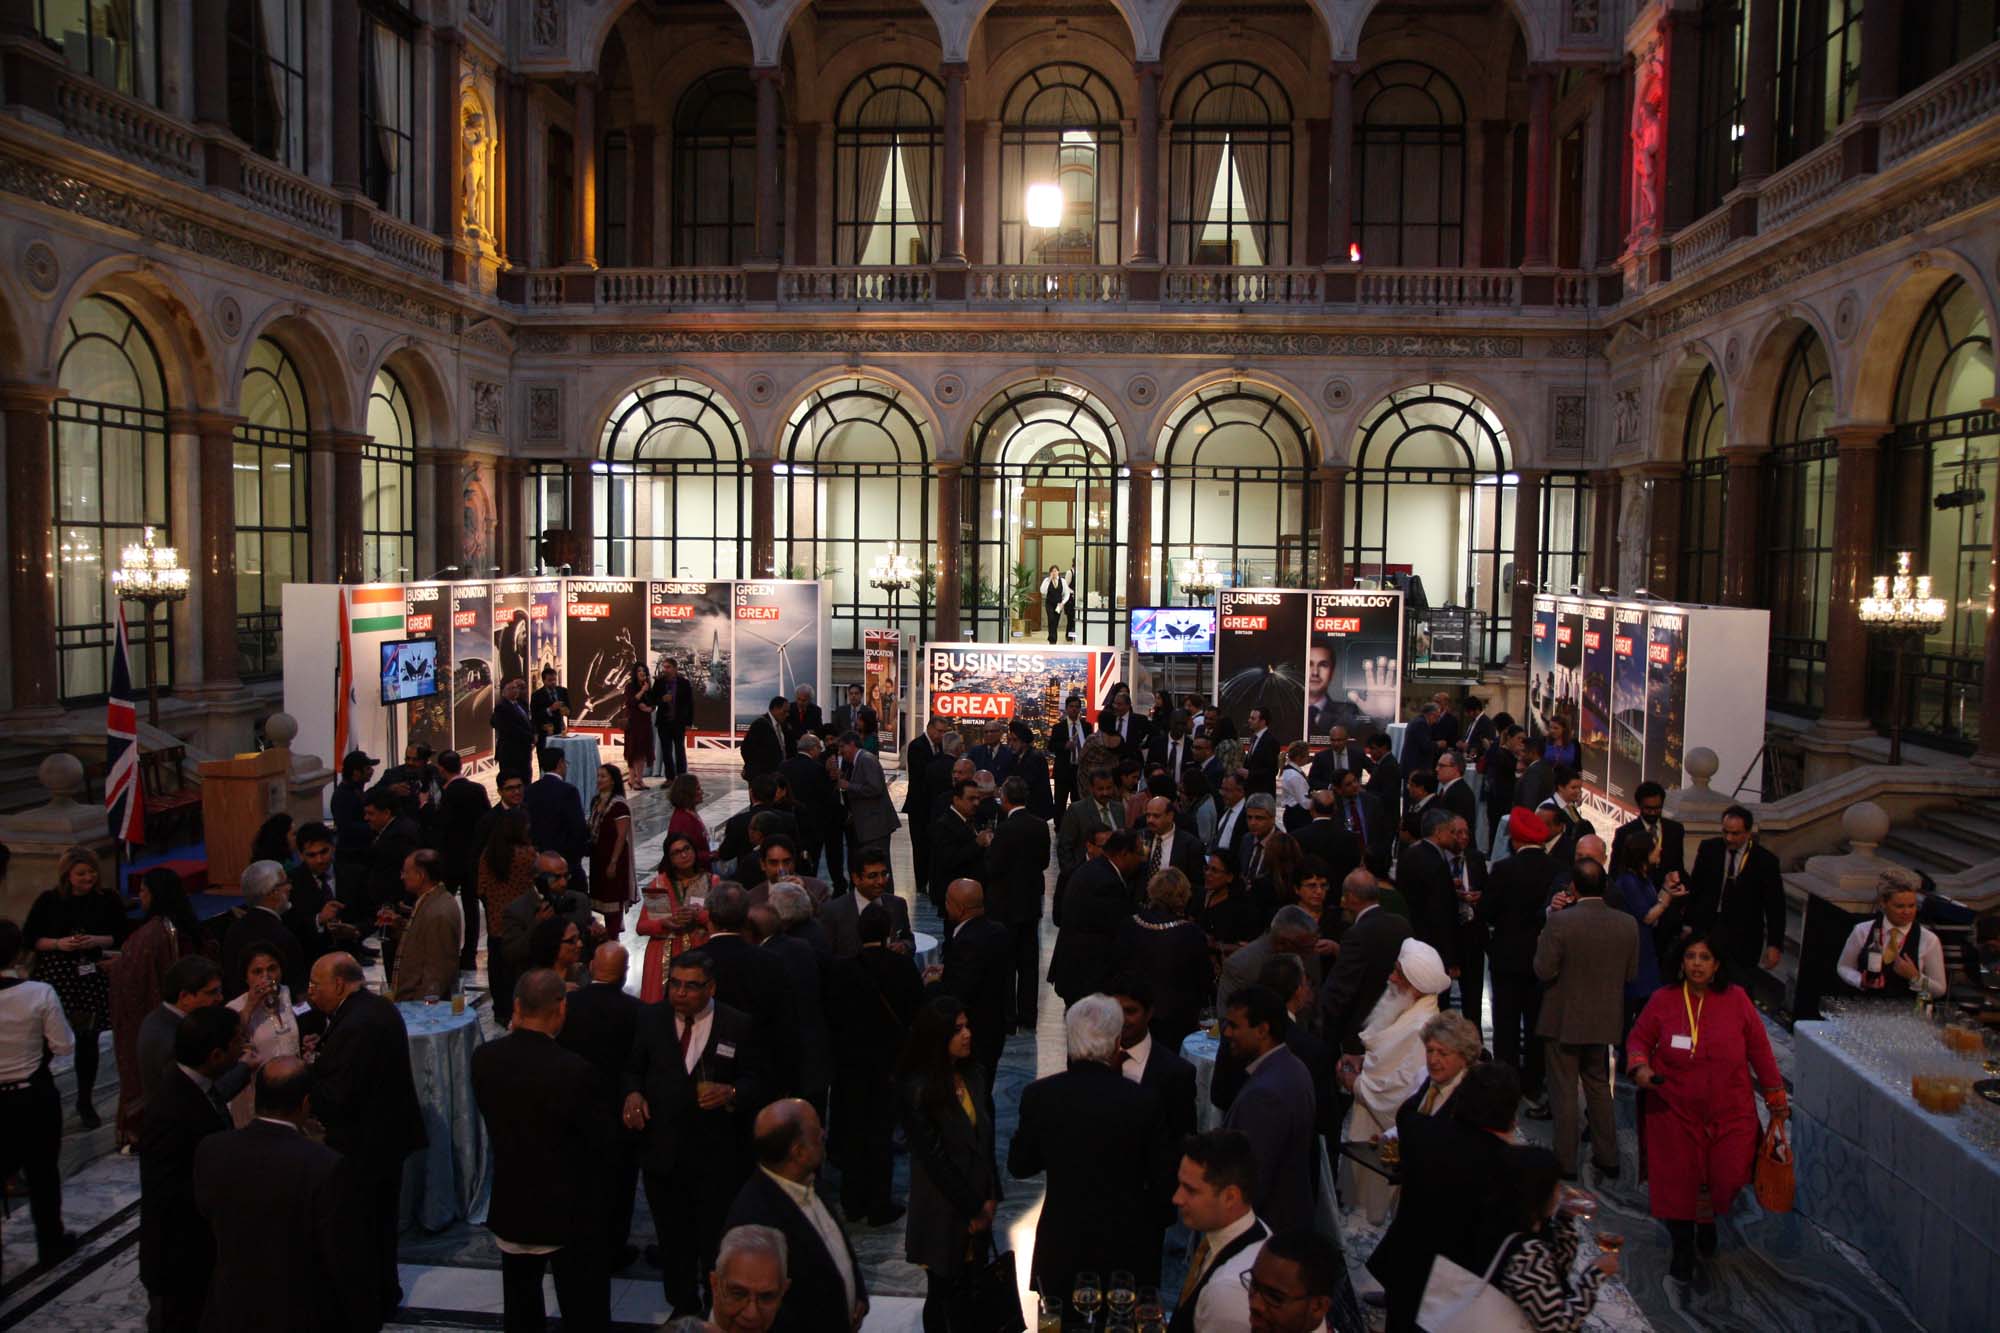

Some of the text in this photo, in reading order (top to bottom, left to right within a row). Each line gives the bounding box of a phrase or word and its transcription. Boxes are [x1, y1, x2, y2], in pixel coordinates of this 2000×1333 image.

[567, 582, 633, 593] INNOVATION
[652, 583, 706, 594] BUSINESS
[736, 585, 774, 595] GREEN
[407, 588, 439, 601] BUSINESS
[567, 592, 579, 603] IS
[652, 594, 662, 604] IS
[1222, 593, 1281, 605] BUSINESS
[736, 596, 748, 605] IS
[1314, 595, 1393, 607] TECHNOLOGY
[407, 602, 415, 615] IS
[569, 605, 609, 616] GREAT
[653, 606, 693, 617] GREAT
[738, 607, 778, 618] GREAT
[1222, 605, 1233, 615] IS
[1316, 607, 1327, 617] IS
[408, 616, 433, 630] GREAT
[454, 612, 476, 626] GREAT
[1223, 617, 1265, 628] GREAT
[1315, 619, 1358, 630] GREAT
[866, 649, 893, 657] EDUCATION
[1650, 645, 1668, 661] GREAT
[934, 652, 1045, 672] BUSINESS
[934, 672, 954, 691] IS
[937, 695, 1011, 715] GREAT
